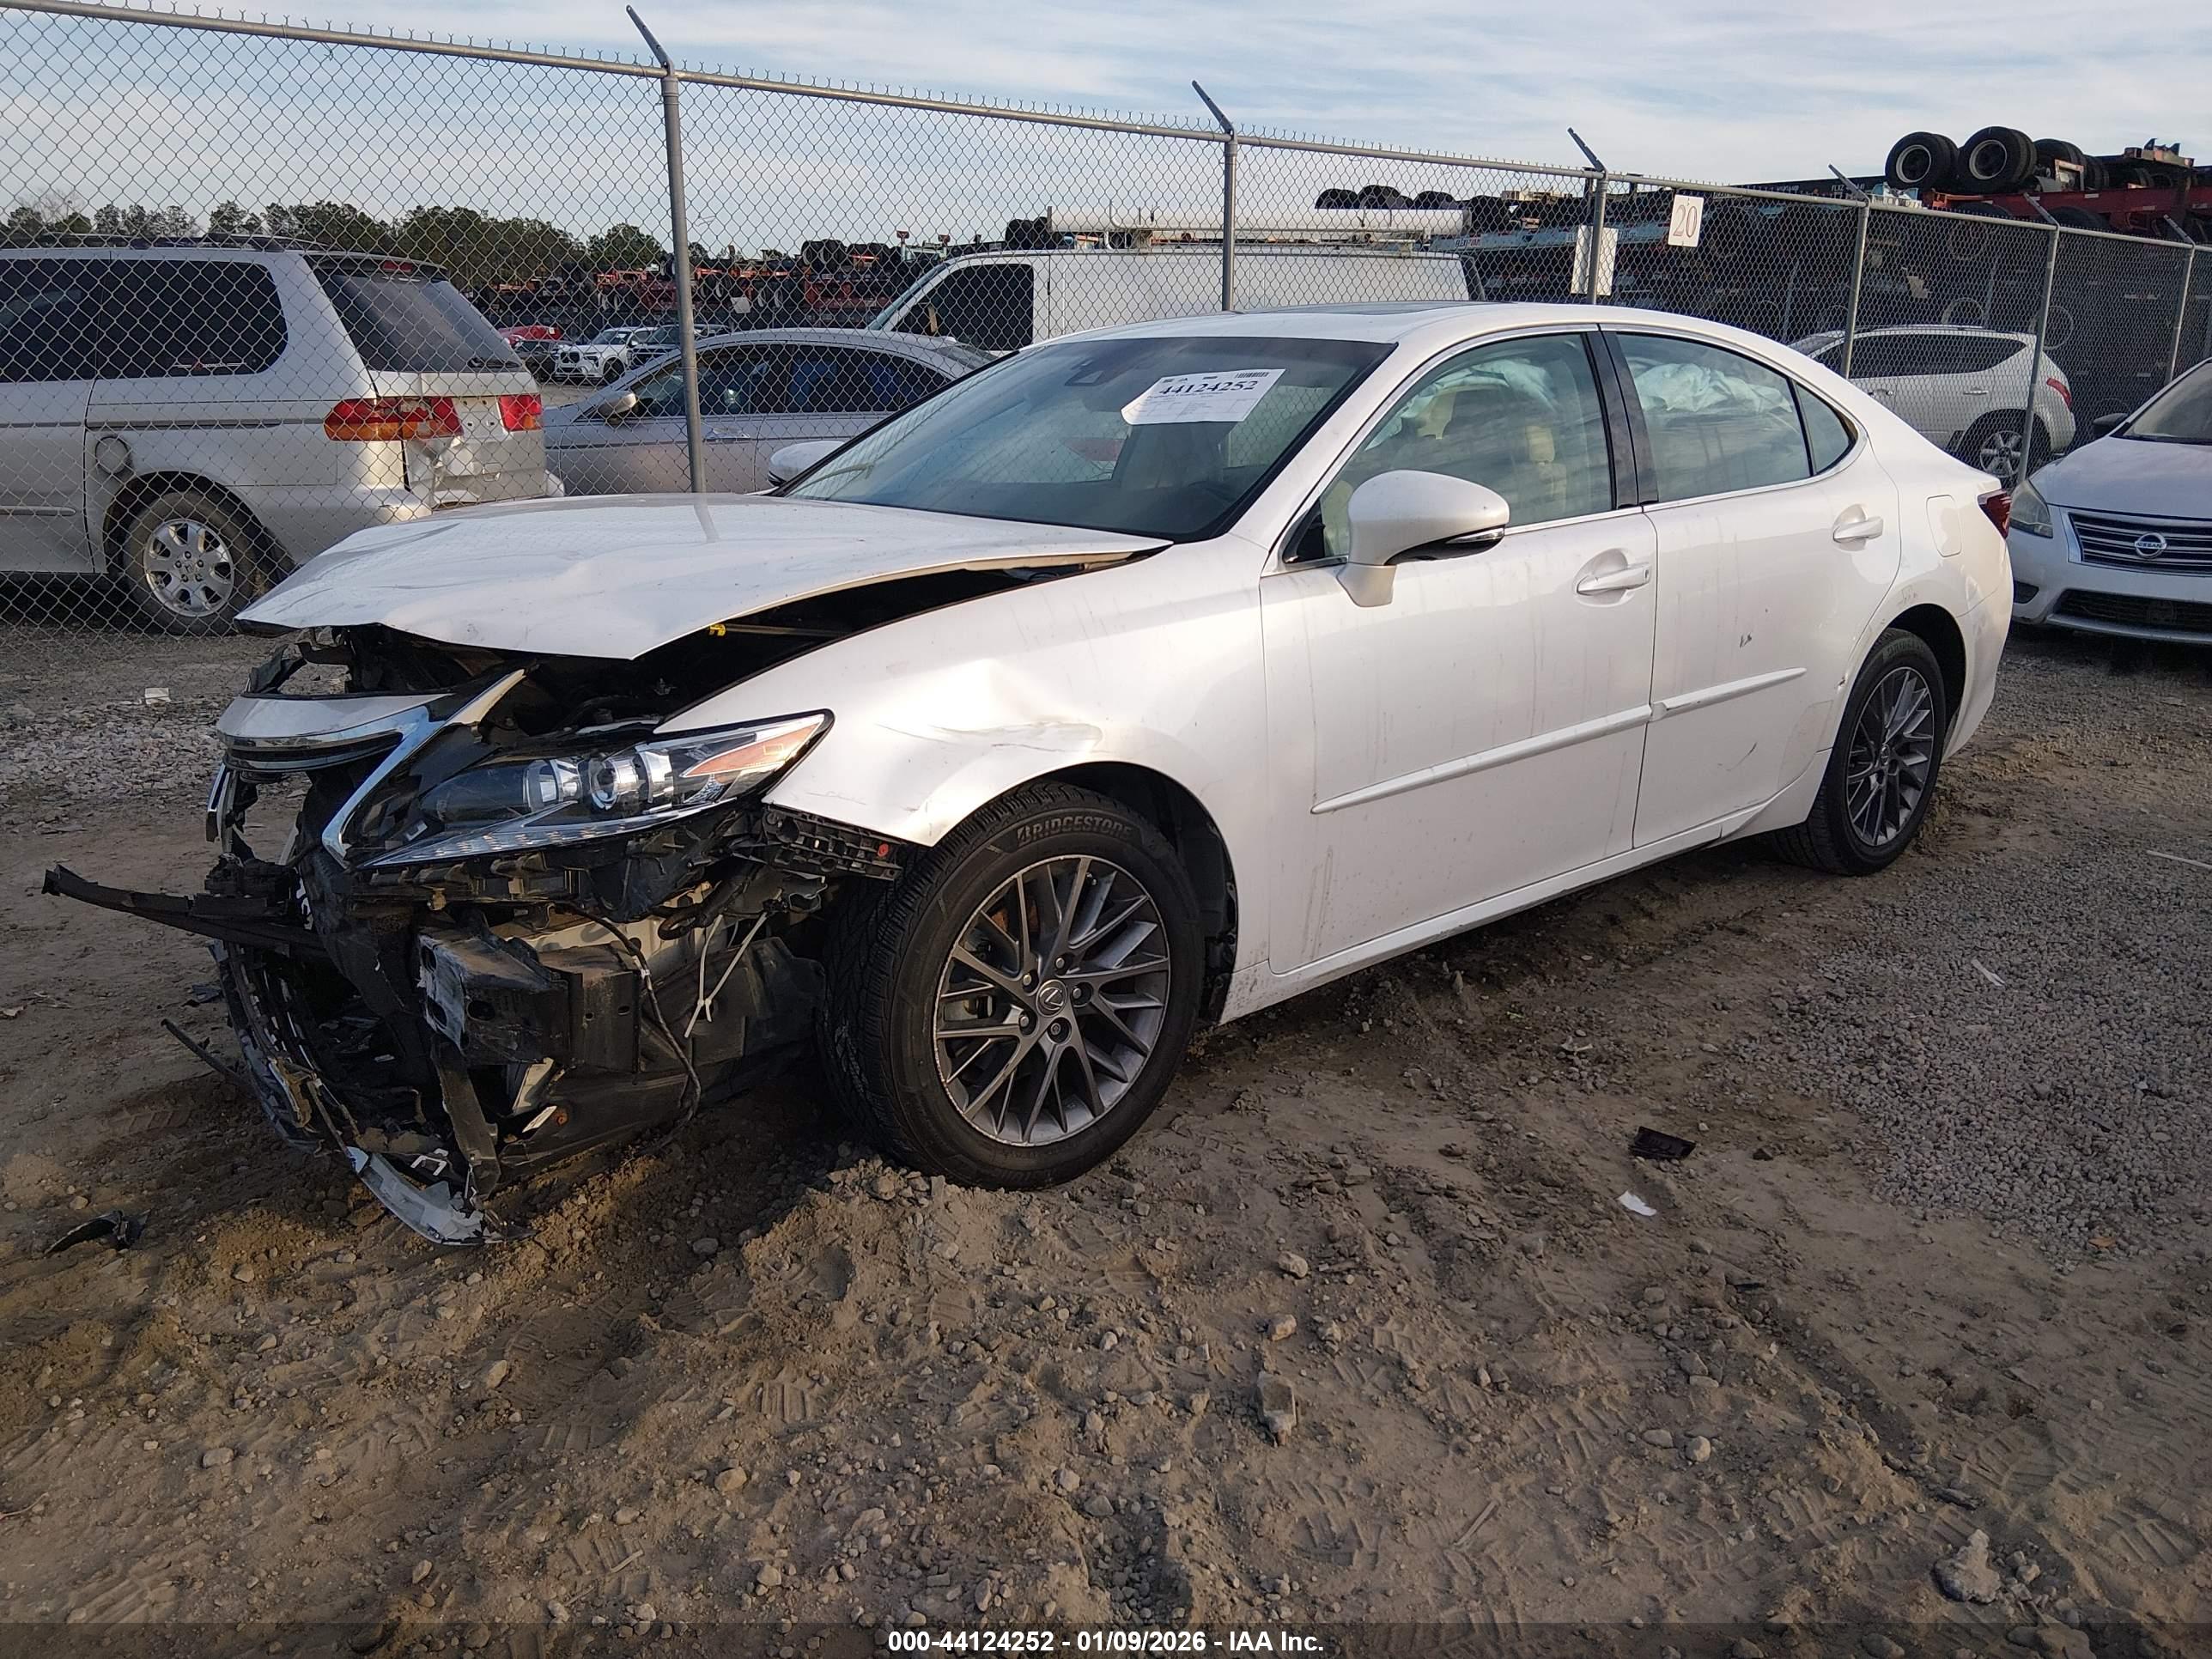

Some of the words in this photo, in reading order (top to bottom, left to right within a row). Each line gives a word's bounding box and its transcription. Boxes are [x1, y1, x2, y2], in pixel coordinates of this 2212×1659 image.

[1673, 204, 1698, 239] 20
[1159, 380, 1259, 395] 44124252
[1017, 816, 1133, 848] BRIDGESTONE
